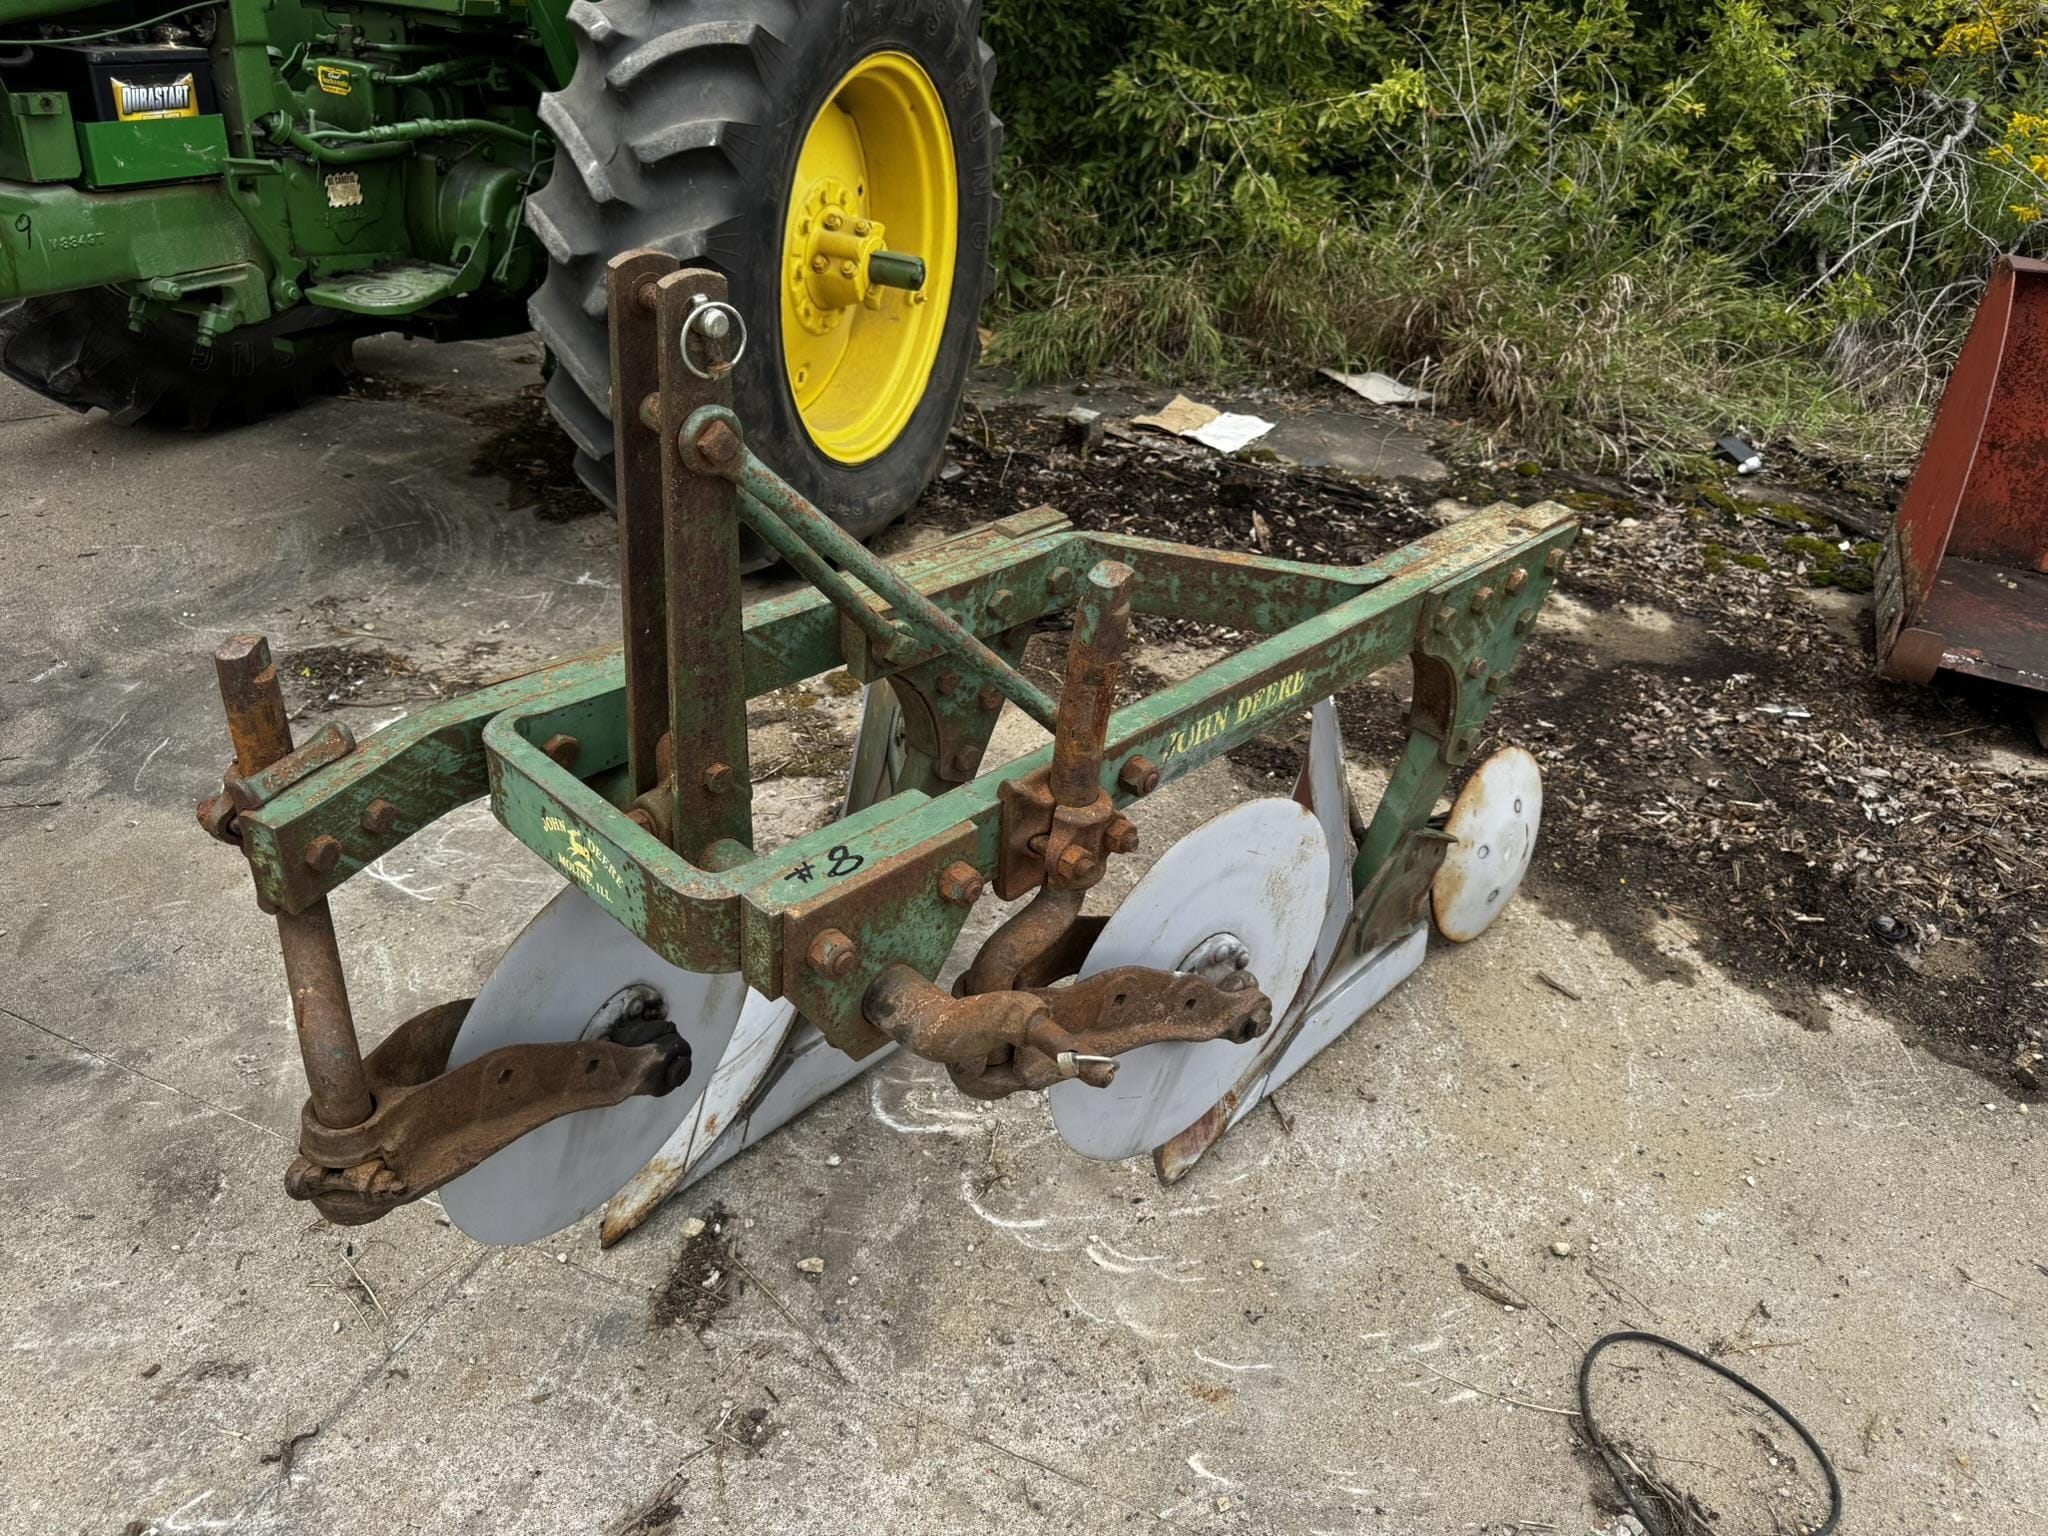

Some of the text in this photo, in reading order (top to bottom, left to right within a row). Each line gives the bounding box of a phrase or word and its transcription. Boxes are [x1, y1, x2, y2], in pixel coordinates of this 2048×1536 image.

[121, 85, 190, 114] DURASTART
[15, 213, 31, 250] 9
[541, 816, 624, 889] JOHN DEERE
[596, 882, 614, 904] ILL.
